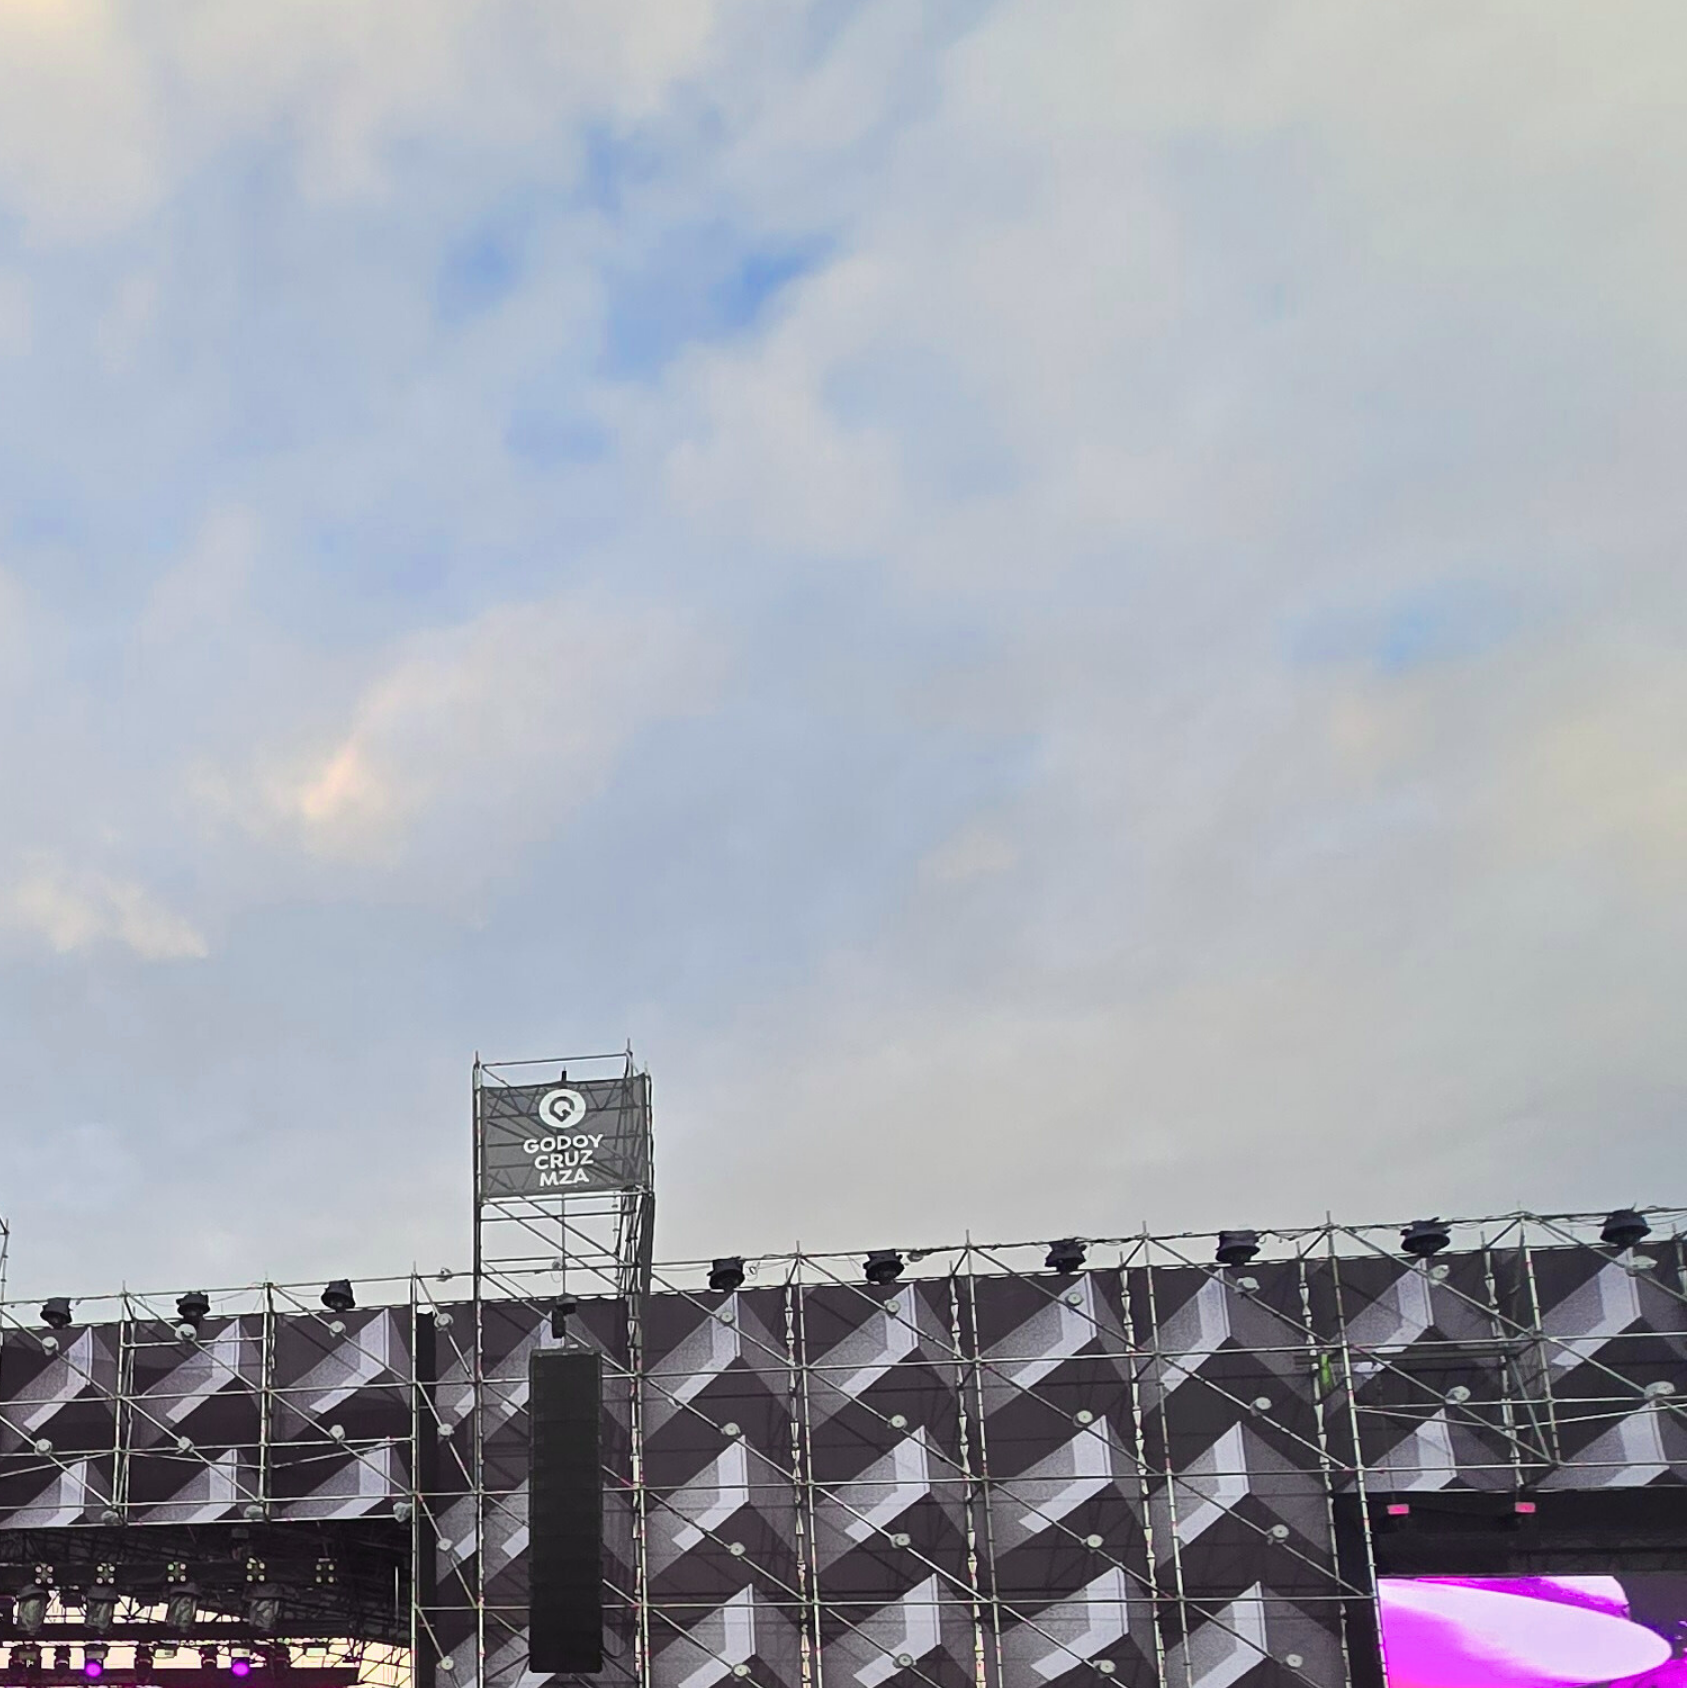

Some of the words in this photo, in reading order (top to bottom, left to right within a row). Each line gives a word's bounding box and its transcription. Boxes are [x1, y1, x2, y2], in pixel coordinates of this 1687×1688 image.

[523, 1133, 604, 1154] GODOY
[534, 1150, 594, 1170] CRUZ
[539, 1168, 590, 1187] MZA
